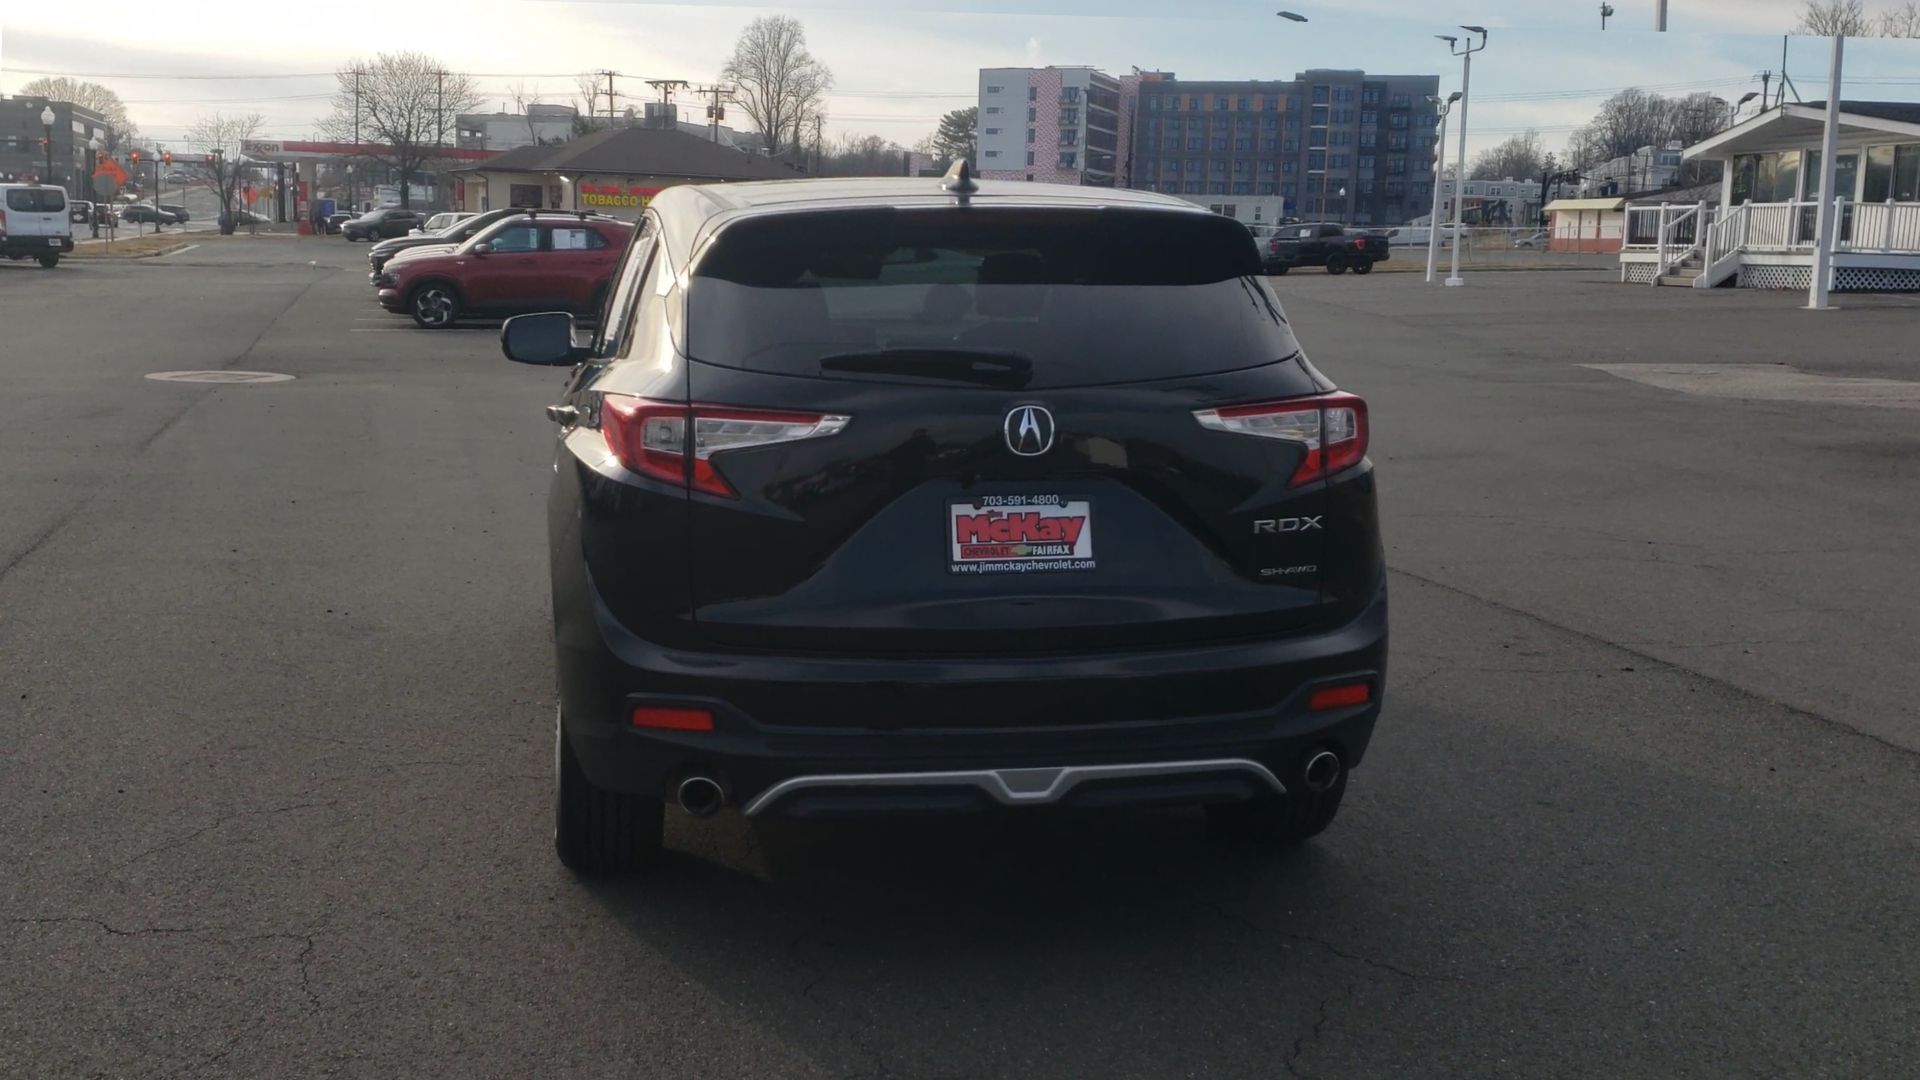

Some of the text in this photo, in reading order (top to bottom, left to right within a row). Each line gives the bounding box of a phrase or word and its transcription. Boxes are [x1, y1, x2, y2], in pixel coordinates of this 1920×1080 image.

[581, 193, 638, 207] TOBACCO
[982, 495, 1059, 506] 703-591-4800
[955, 512, 1086, 546] McKay
[1254, 515, 1323, 534] RDX
[1032, 545, 1070, 556] FAIRFAX
[951, 560, 1096, 573] www.jimmckaychevrolet.com
